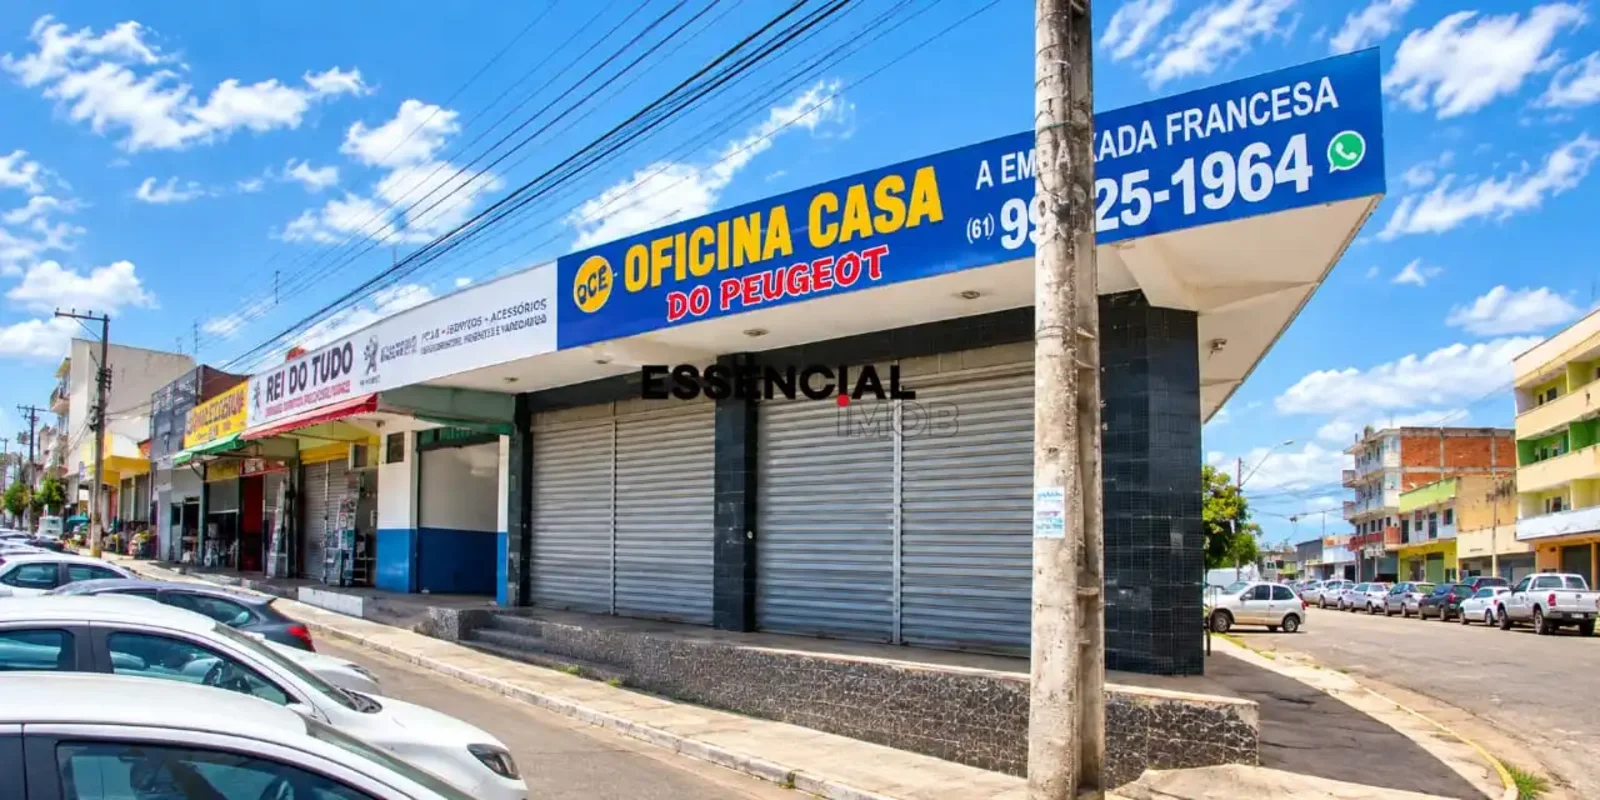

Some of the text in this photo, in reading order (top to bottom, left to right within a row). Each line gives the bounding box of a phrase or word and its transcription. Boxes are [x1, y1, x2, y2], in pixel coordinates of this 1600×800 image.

[976, 160, 994, 190] A
[1166, 76, 1339, 145] FRANCESA
[624, 165, 944, 294] OFICINA CASA
[966, 133, 1313, 250] (61) 9925-1964
[490, 298, 547, 323] ACESSÓRIOS
[666, 245, 890, 323] DO PEUGEOT
[266, 370, 285, 403] REI
[289, 361, 307, 395] DO
[312, 341, 353, 386] TUDO
